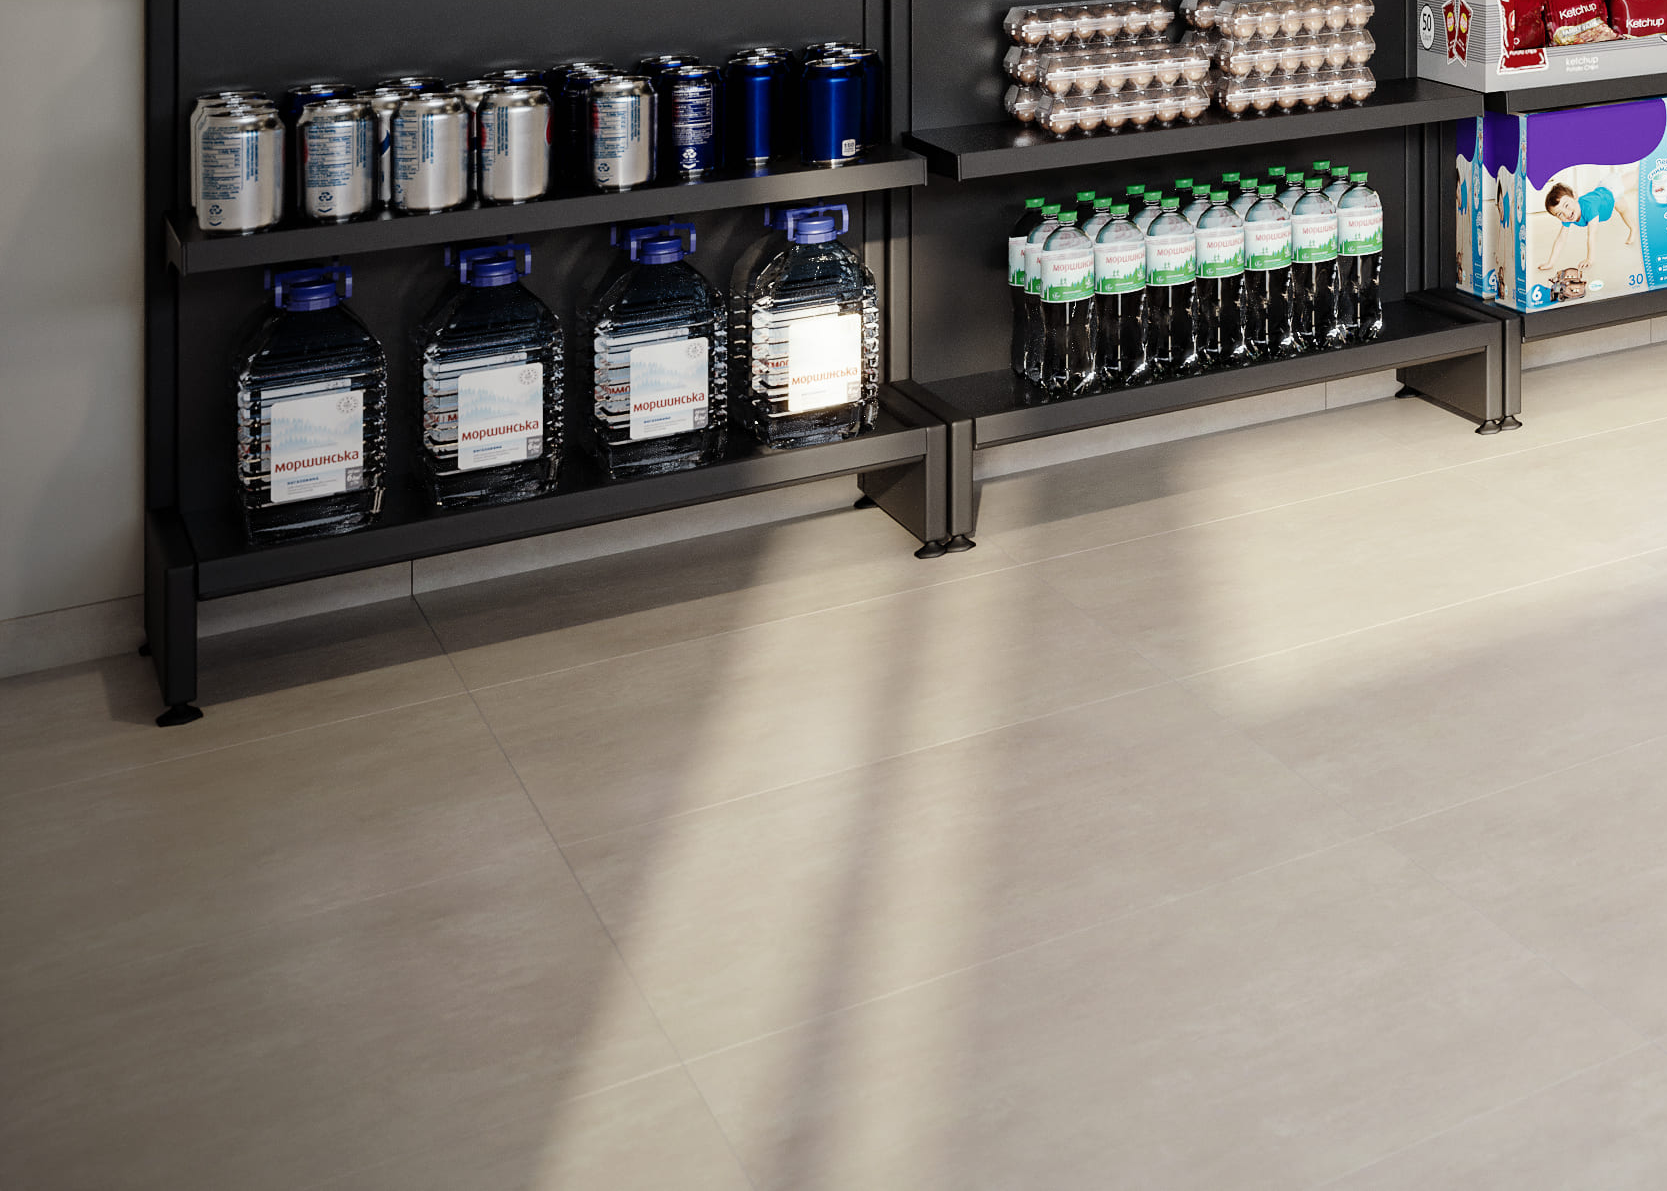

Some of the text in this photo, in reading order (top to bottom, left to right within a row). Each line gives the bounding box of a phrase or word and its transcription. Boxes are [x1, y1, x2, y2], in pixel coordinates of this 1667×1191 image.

[1559, 2, 1597, 20] Ketchup
[1422, 13, 1432, 31] 50
[1625, 17, 1664, 28] Ketchup
[1628, 273, 1644, 287] 30
[1532, 285, 1542, 301] 6
[791, 366, 858, 385] моршинська
[633, 392, 705, 412] моршинська
[461, 419, 539, 441] моршинська
[274, 450, 359, 473] моршинська
